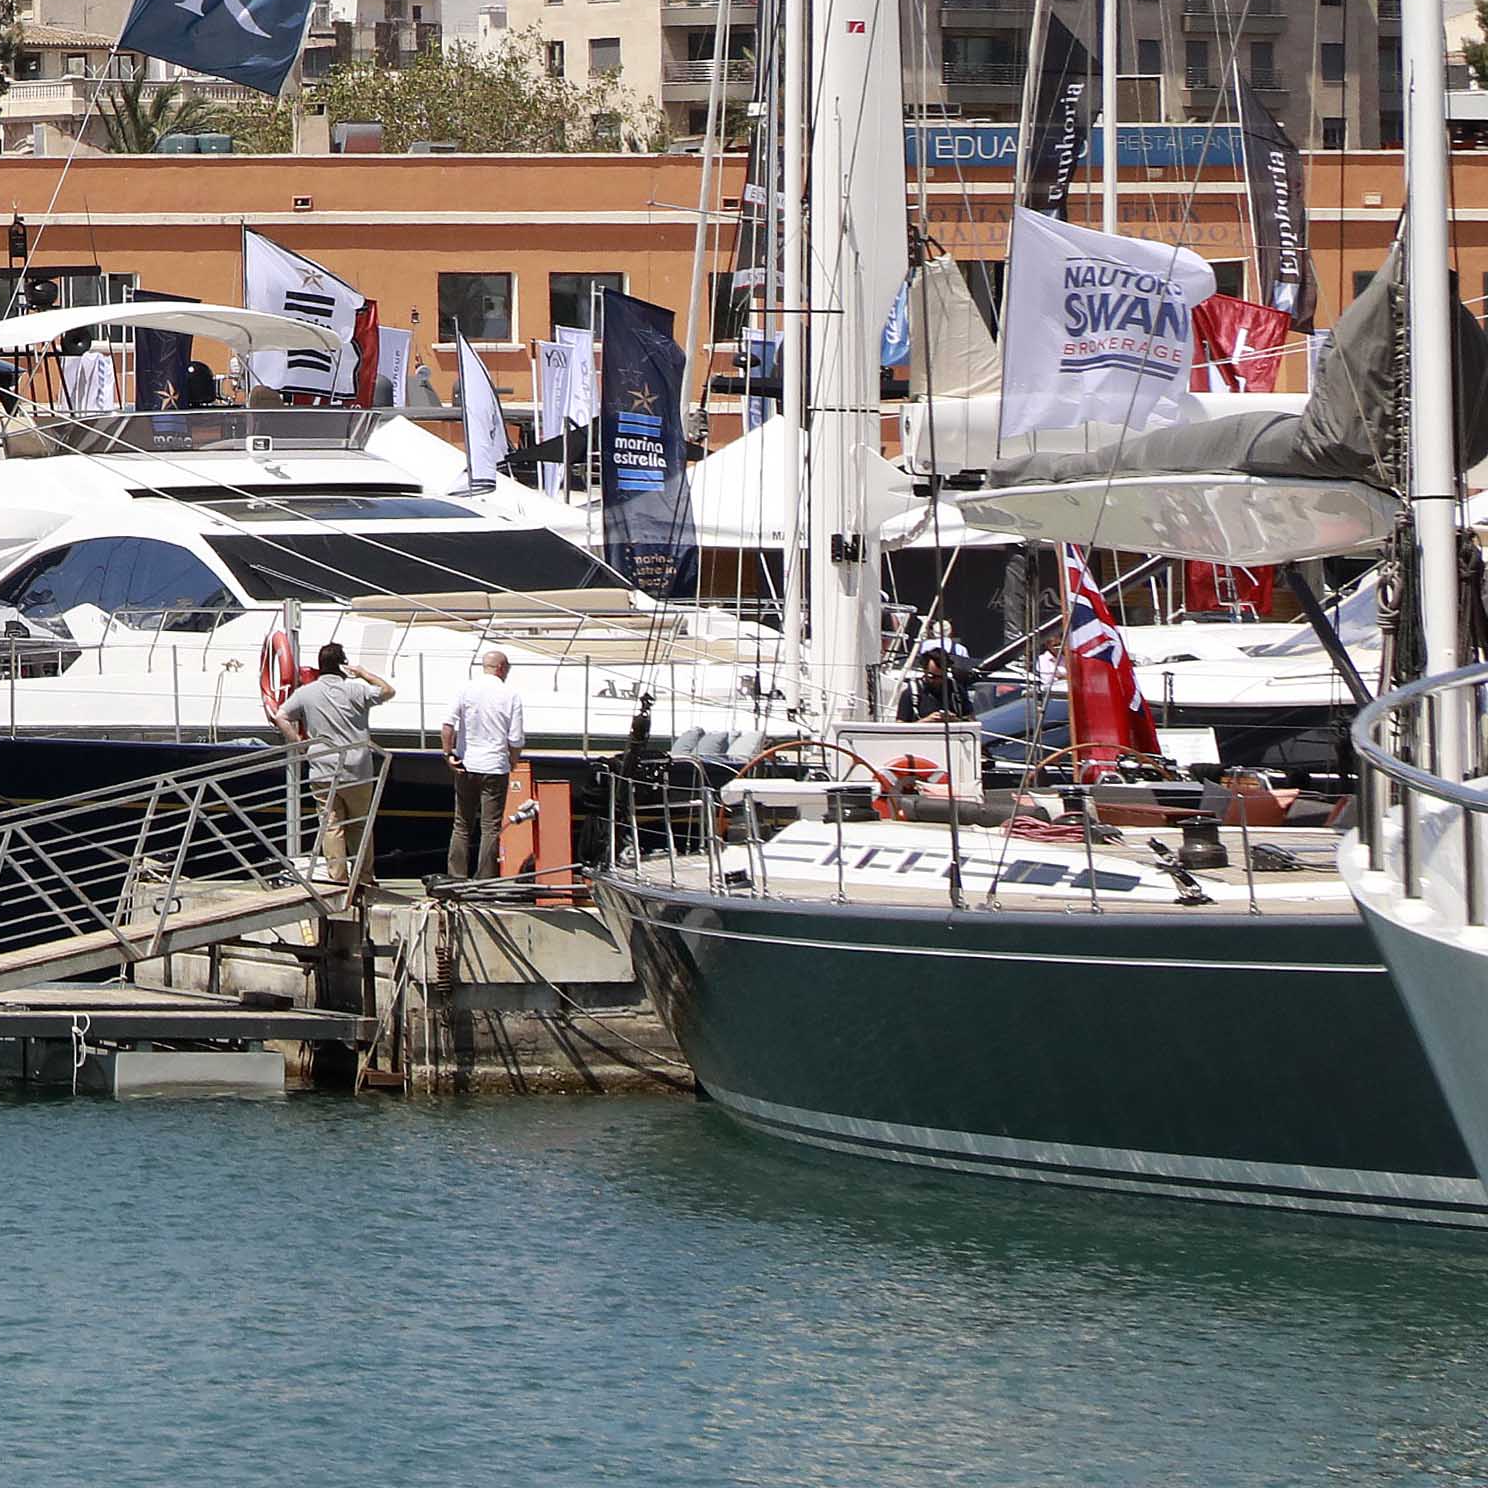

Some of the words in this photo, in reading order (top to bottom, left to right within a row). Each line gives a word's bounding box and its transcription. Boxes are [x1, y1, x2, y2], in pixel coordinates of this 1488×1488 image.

[1065, 292, 1189, 343] SWAN
[1064, 336, 1183, 363] BROKERAGE
[615, 436, 664, 454] marina
[613, 451, 667, 468] estrella
